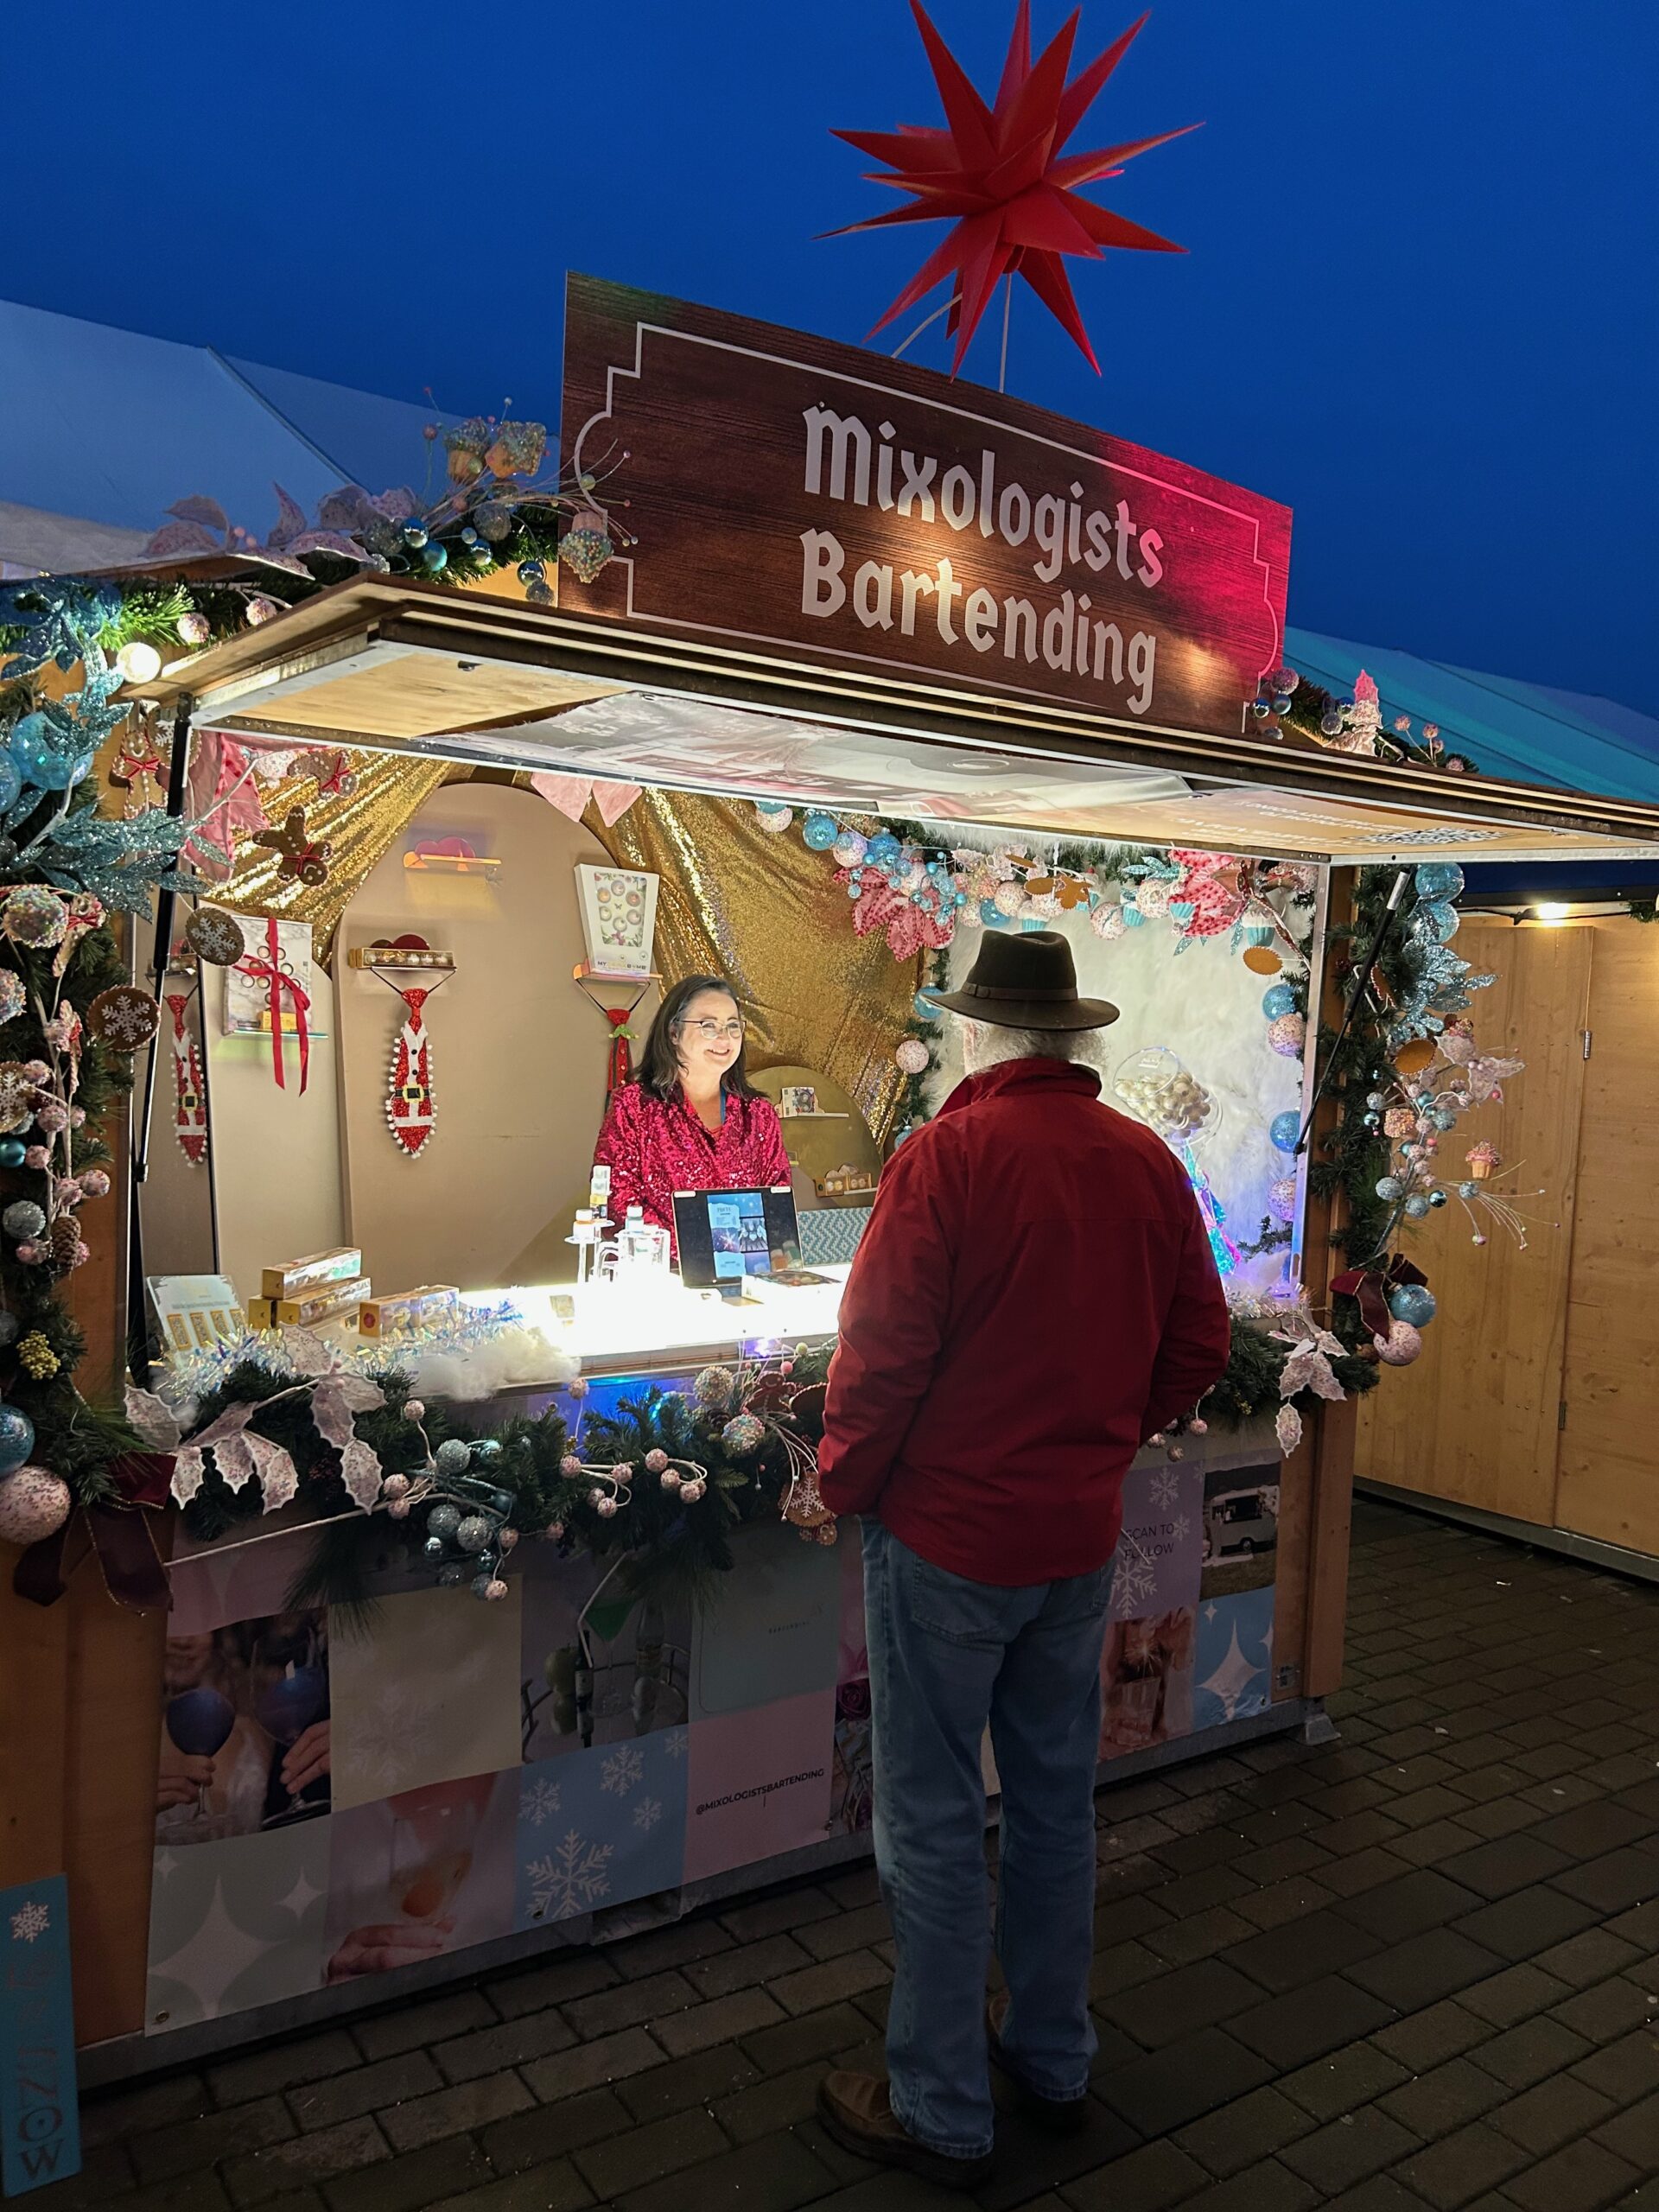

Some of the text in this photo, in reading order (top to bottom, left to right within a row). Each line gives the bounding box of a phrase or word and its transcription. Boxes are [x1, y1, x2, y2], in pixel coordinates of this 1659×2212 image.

[803, 403, 1165, 588] Mixologists
[800, 527, 1156, 715] Bartending
[1125, 1523, 1173, 1540] SCAN TO
[696, 1769, 824, 1815] @MIXOLOGISTSBARTENDING
